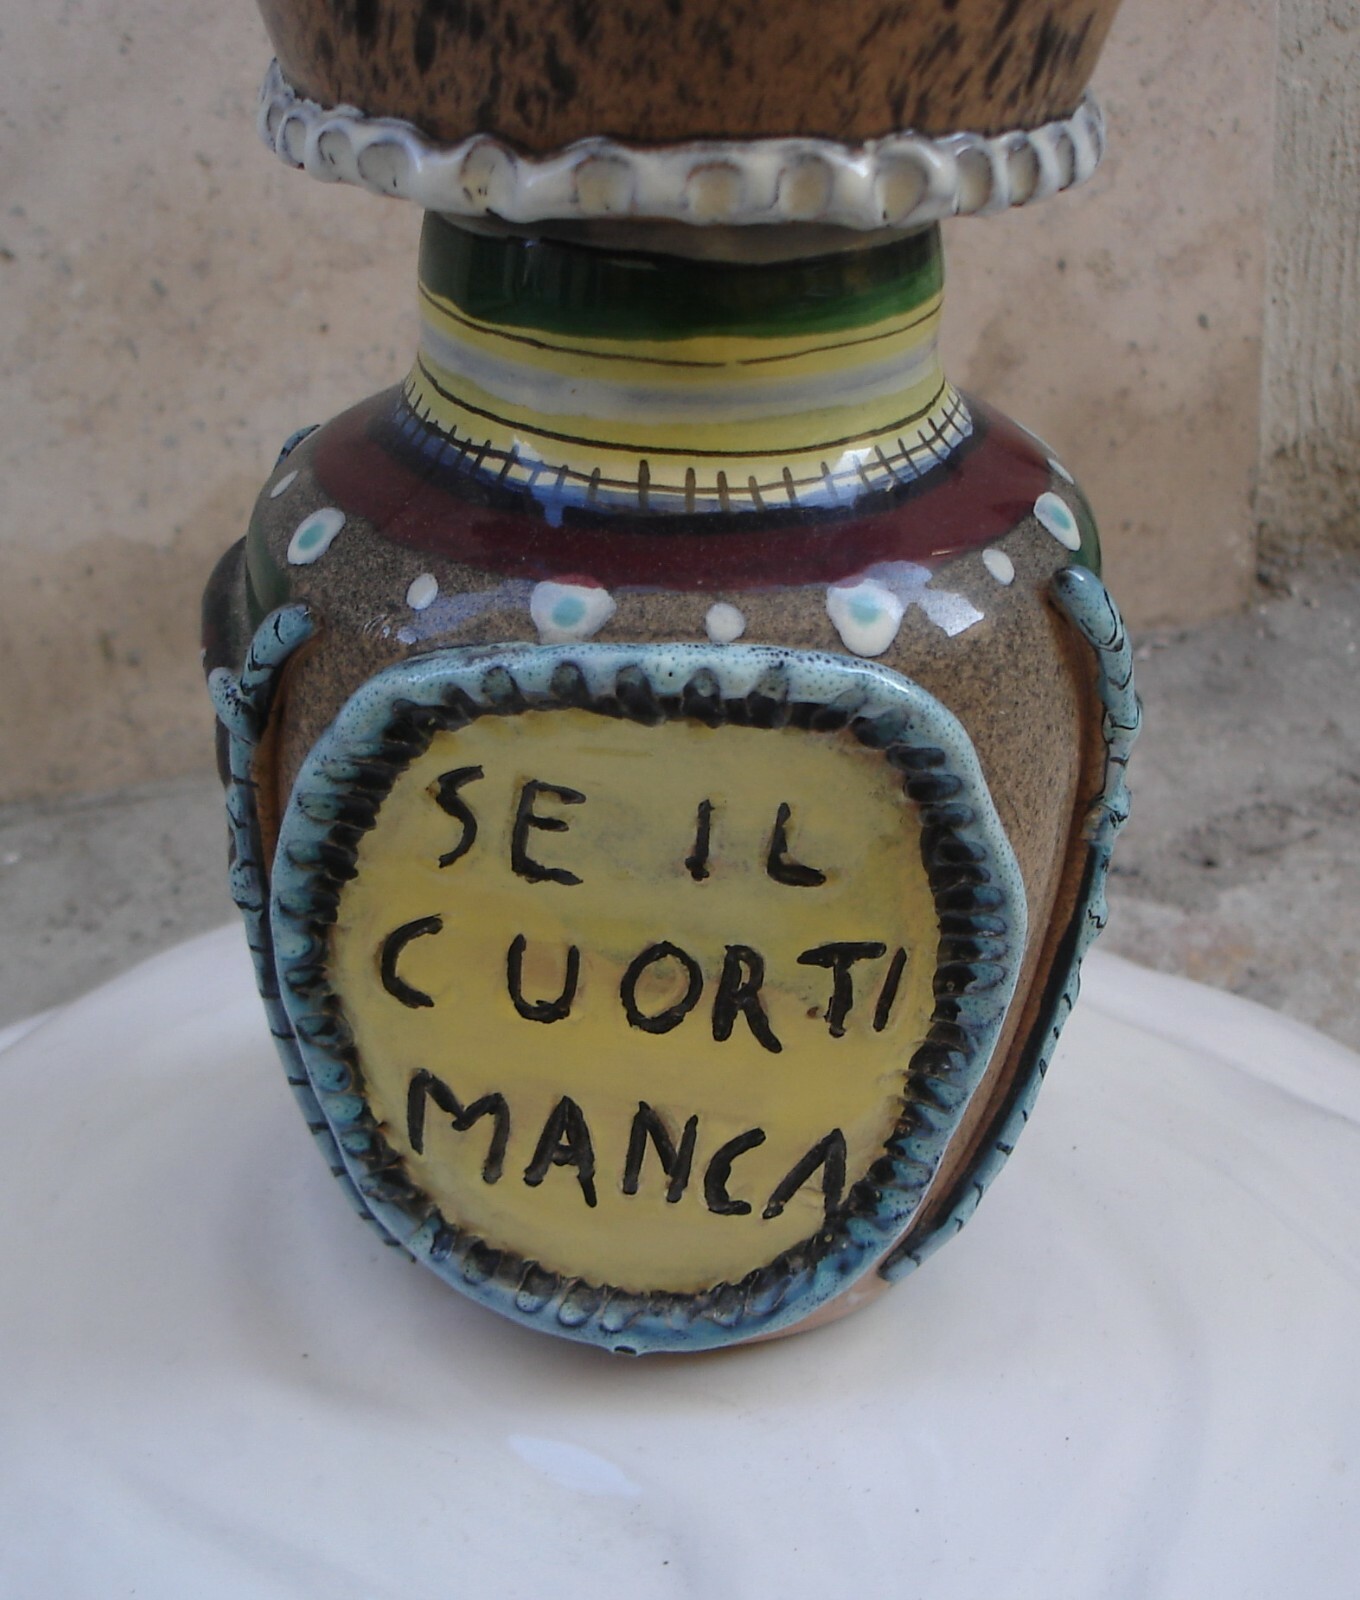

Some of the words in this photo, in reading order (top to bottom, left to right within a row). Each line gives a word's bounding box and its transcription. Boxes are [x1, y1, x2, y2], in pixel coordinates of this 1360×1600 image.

[430, 764, 587, 886] SE
[684, 798, 828, 888] IL
[406, 1068, 848, 1221] MANCA
